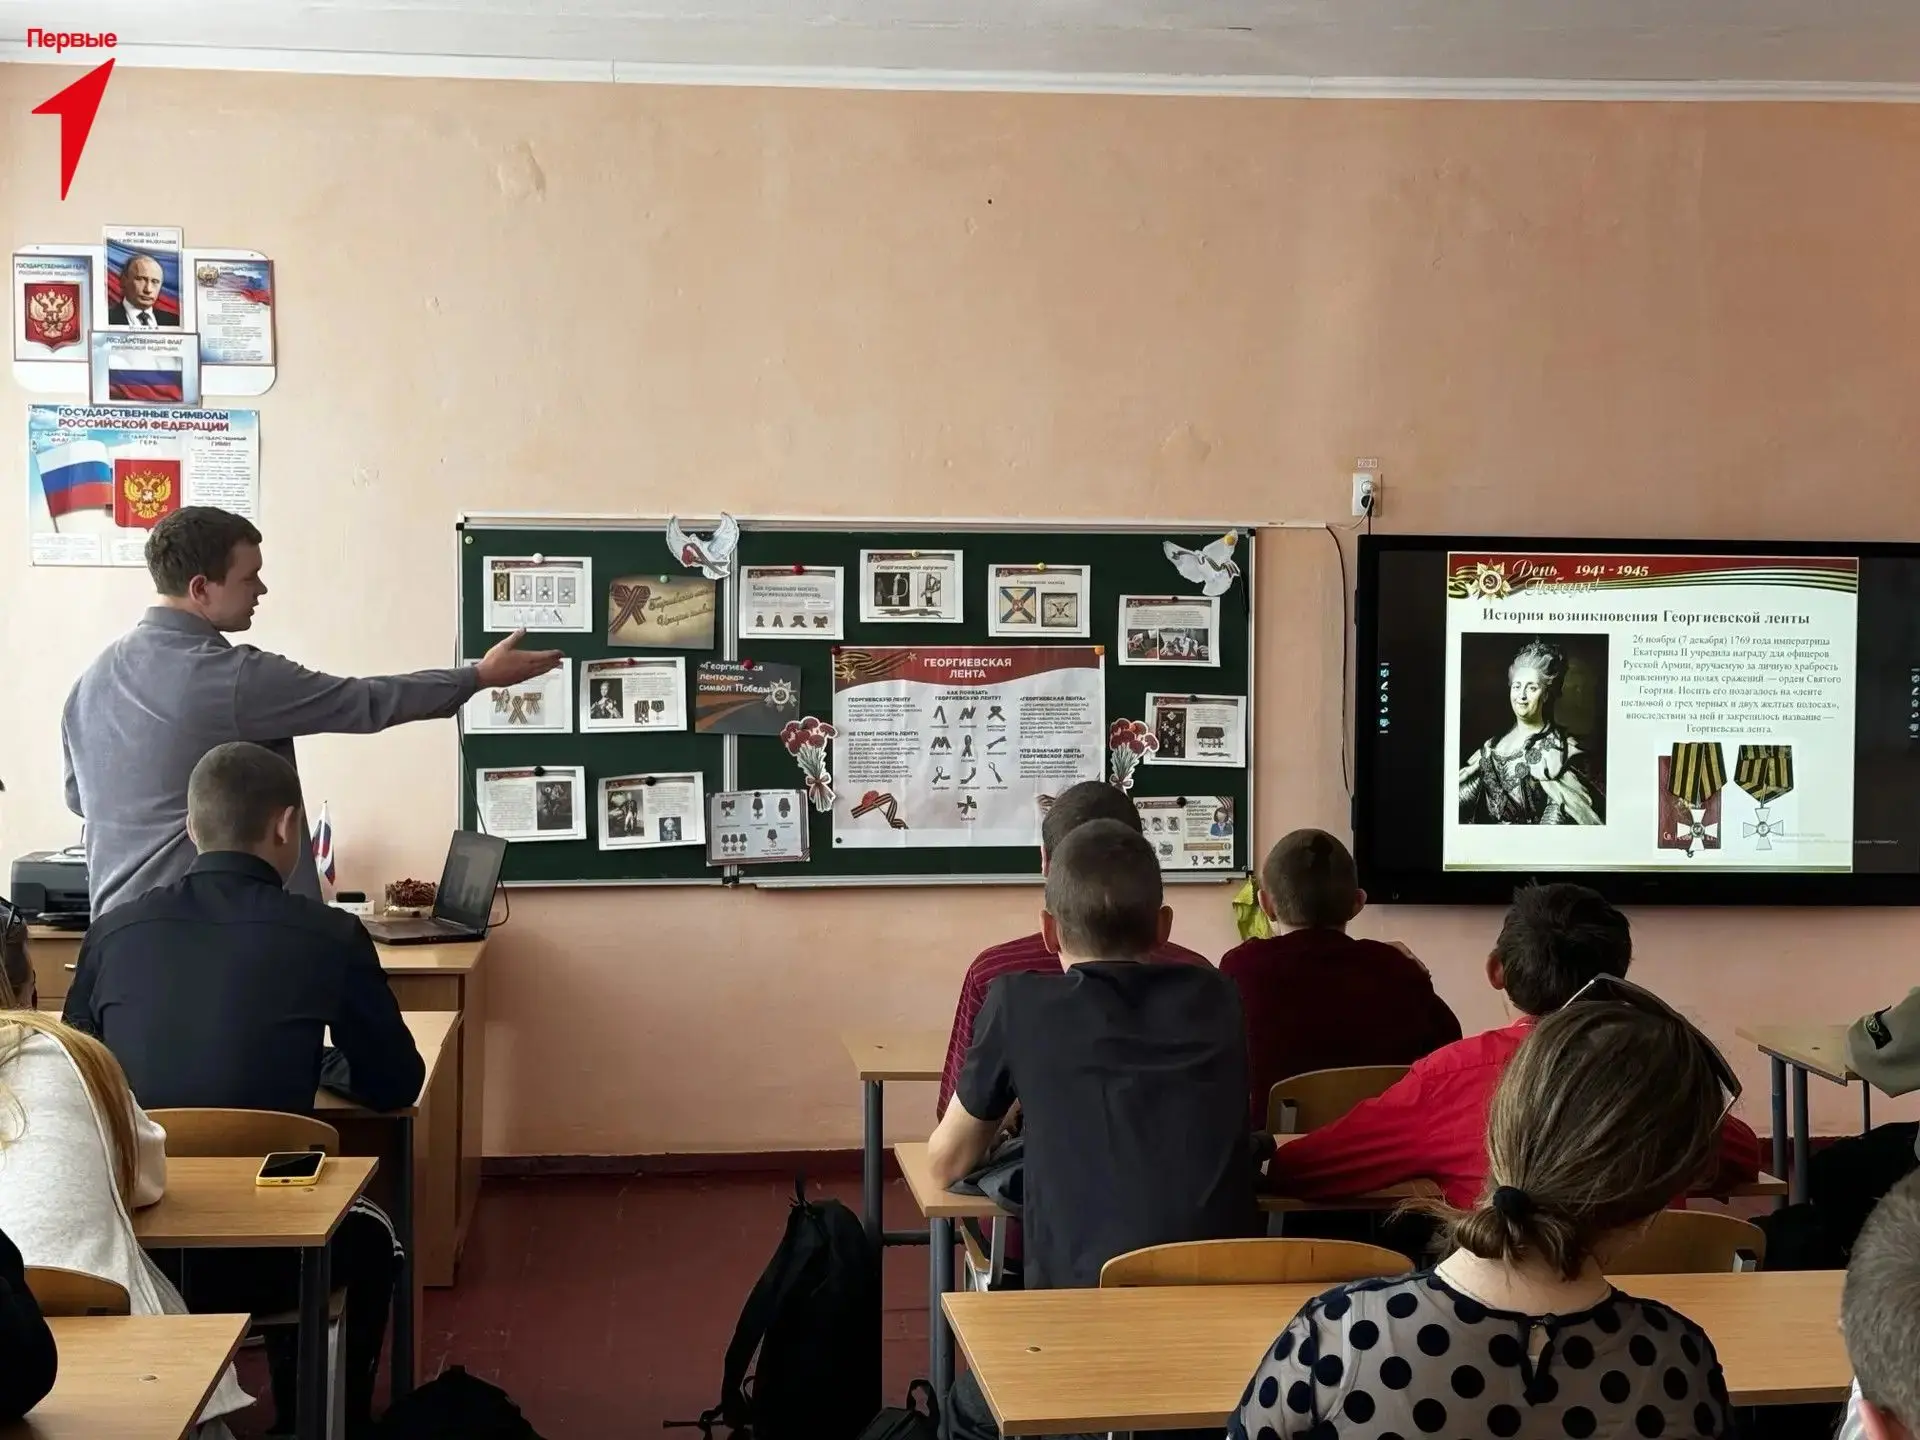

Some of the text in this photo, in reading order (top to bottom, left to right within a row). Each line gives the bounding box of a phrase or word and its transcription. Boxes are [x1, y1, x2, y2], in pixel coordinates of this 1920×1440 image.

[58, 407, 229, 420] ГОСУДАРСТВЕННЫЕ СИМВОЛЫ
[58, 418, 229, 432] РОССИЙСКОЙ ФЕДЕРАЦИИ
[1512, 559, 1559, 578] День
[1575, 564, 1605, 578] 1941
[1616, 564, 1650, 577] 1945
[1483, 608, 1810, 626] История возникновения Георгиевской ленты
[1632, 634, 1644, 644] 26
[1645, 635, 1676, 646] ноября
[1689, 635, 1728, 647] декабря)
[1730, 635, 1750, 645] 1769
[1752, 637, 1772, 646] года
[1773, 638, 1831, 648] императрица
[1633, 647, 1679, 658] Екатерина
[1690, 650, 1731, 659] учредила
[1732, 650, 1767, 660] награду
[1769, 650, 1785, 658] для
[1786, 649, 1830, 660] офицеров
[699, 661, 764, 672] «Георгиевая
[923, 657, 1012, 668] ГЕОРГИЕВСКАЯ
[1623, 659, 1659, 670] Русской
[1696, 663, 1745, 672] вручаемую
[1757, 663, 1792, 672] личную
[1794, 661, 1839, 672] храбрость
[948, 669, 986, 679] ЛЕНТА
[1721, 674, 1764, 684] сражений
[1778, 676, 1804, 685] орден
[1806, 675, 1842, 684] Святого
[698, 683, 771, 693] символ Победы
[1678, 686, 1711, 695] Носить
[1695, 700, 1728, 709] черных
[1686, 723, 1744, 735] Георгиевская
